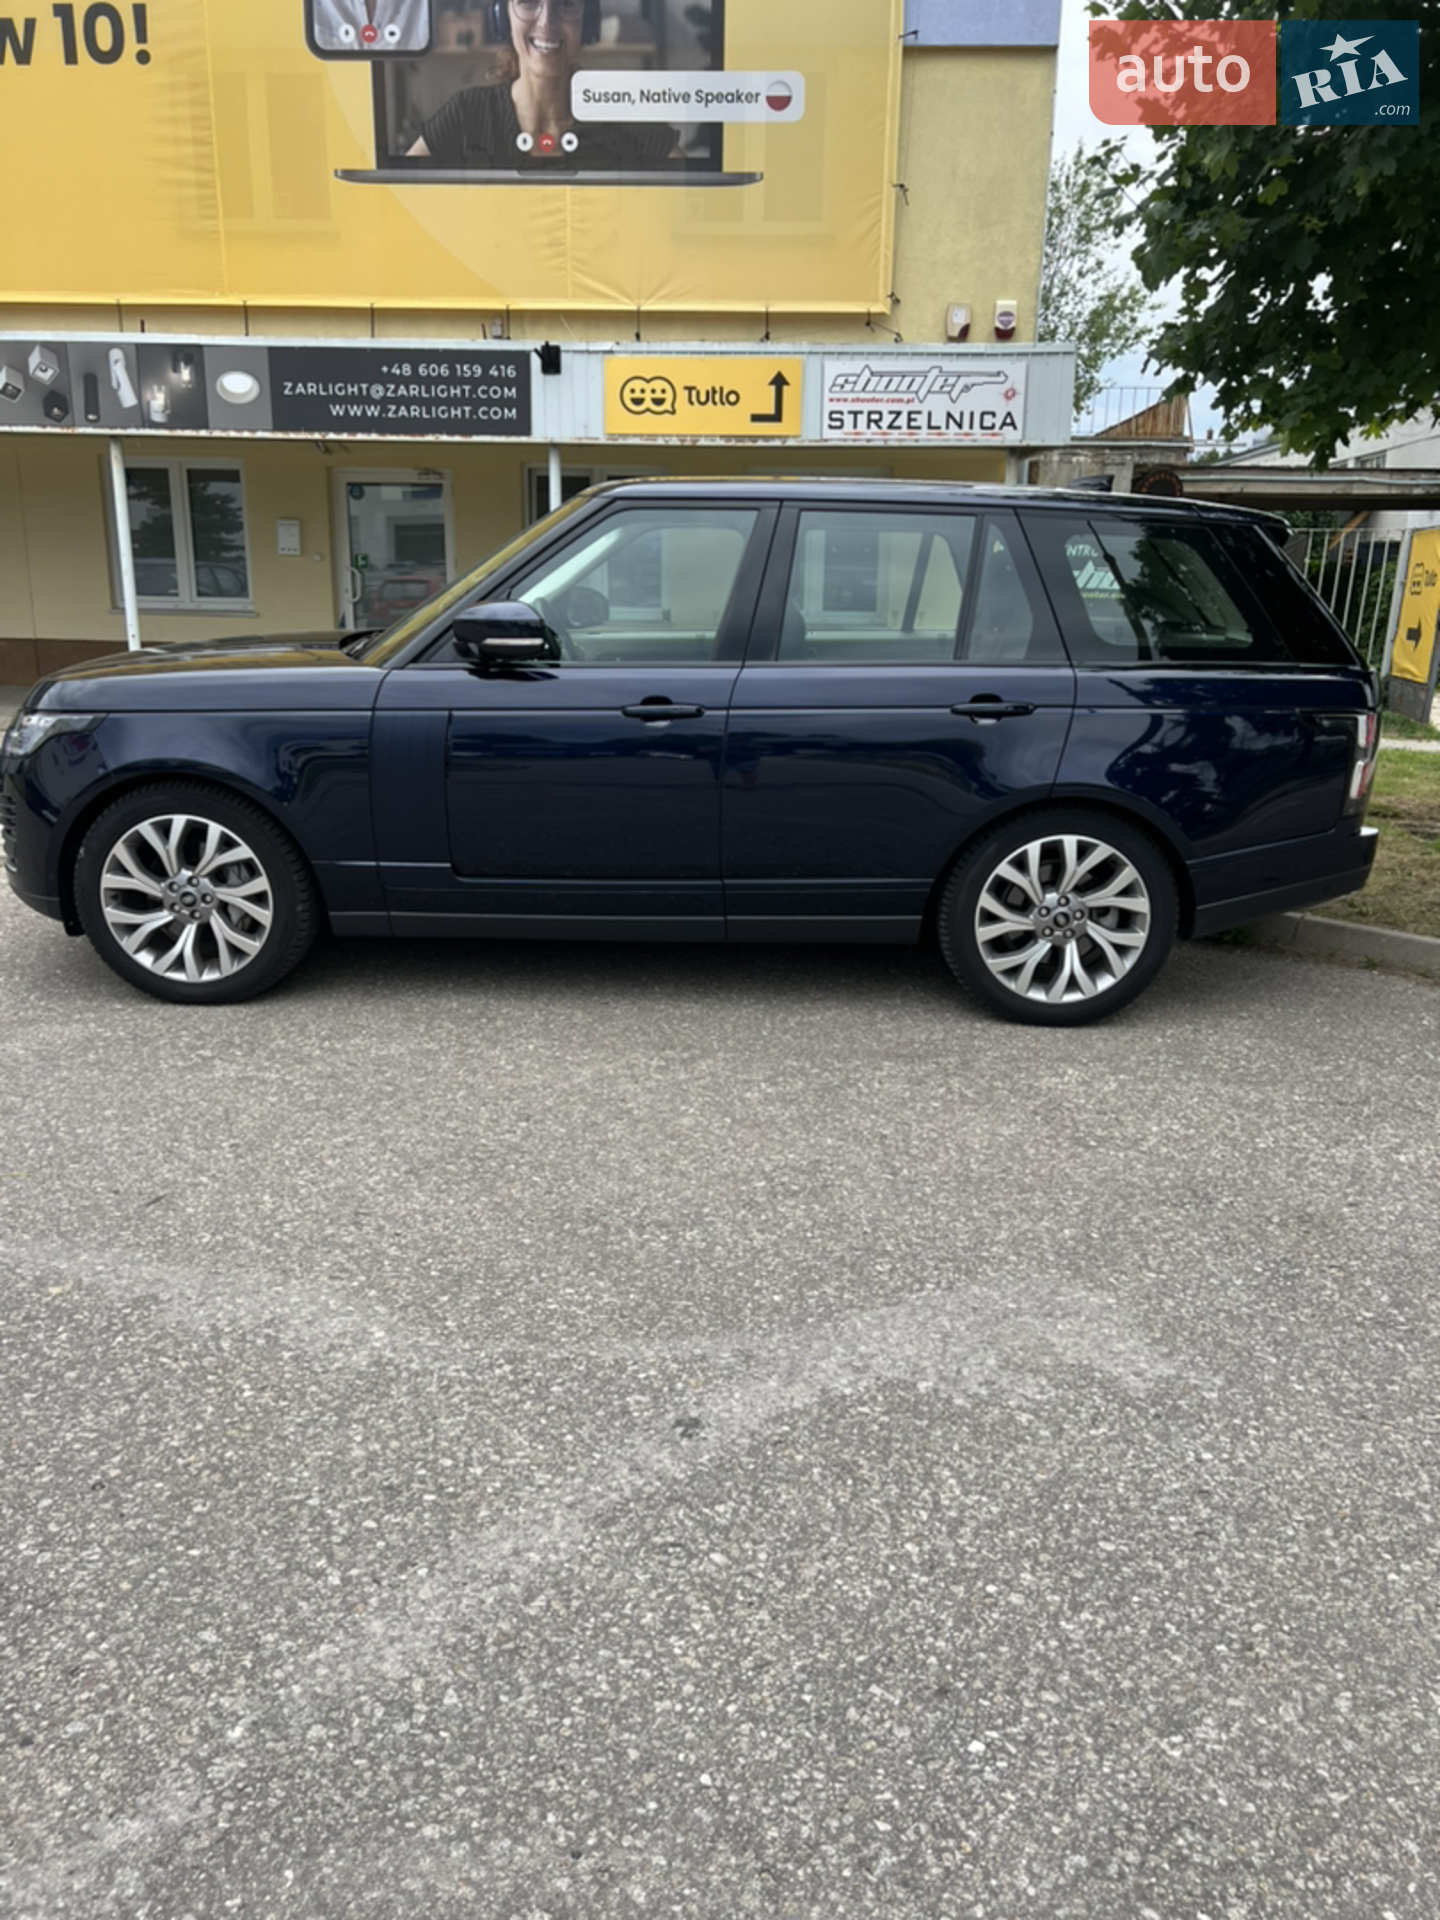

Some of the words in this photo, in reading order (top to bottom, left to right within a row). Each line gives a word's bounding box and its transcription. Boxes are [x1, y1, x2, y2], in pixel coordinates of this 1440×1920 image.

[52, 1, 151, 66] 10!
[582, 88, 636, 105] Susan,
[639, 87, 691, 104] Native
[694, 88, 761, 108] Speaker
[381, 363, 412, 376] +48
[418, 363, 450, 376] 606
[455, 364, 482, 377] 159
[489, 364, 517, 378] 416
[283, 381, 517, 400] ZARLIGHT@ZARLIGHT.COM
[683, 385, 741, 407] Tutlo
[329, 404, 517, 420] WWW.ZARLIGHT.COM
[828, 410, 1018, 431] STRZELNICA
